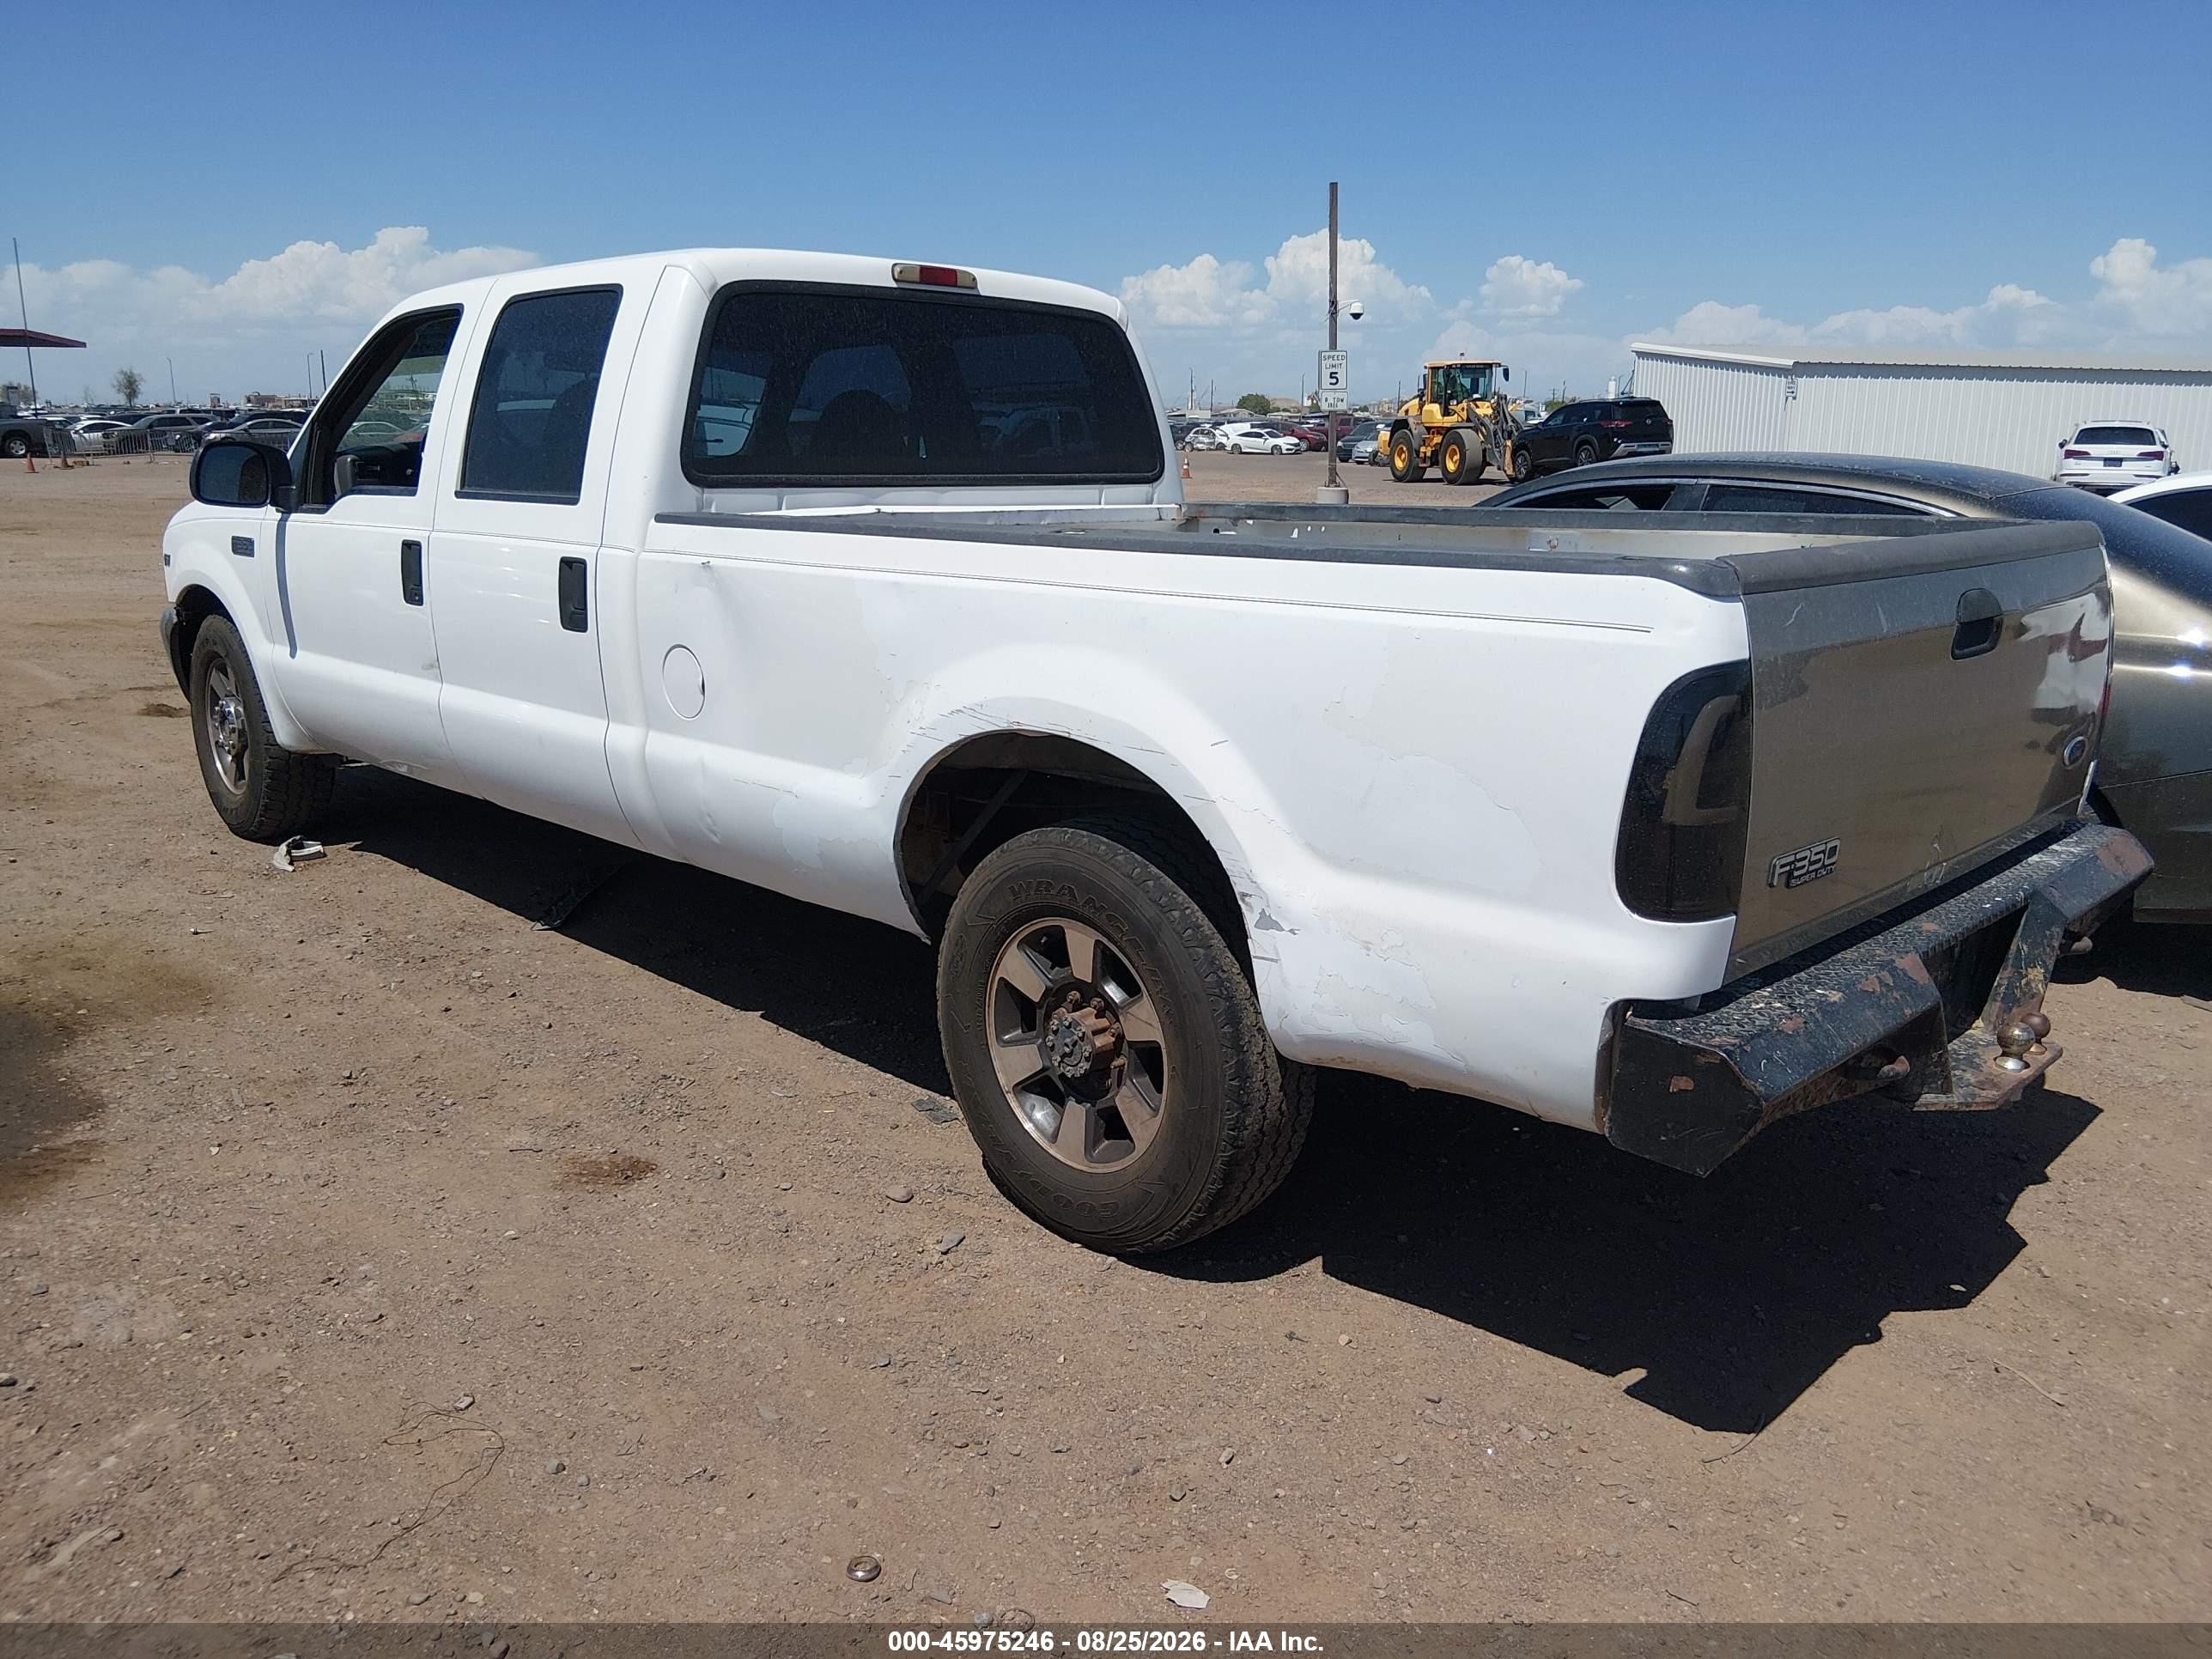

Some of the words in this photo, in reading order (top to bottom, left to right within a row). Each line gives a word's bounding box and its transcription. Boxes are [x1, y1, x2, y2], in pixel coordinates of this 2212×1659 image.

[1328, 371, 1339, 386] 5
[1790, 871, 1816, 886] SUPER
[1816, 864, 1837, 878] DUTY
